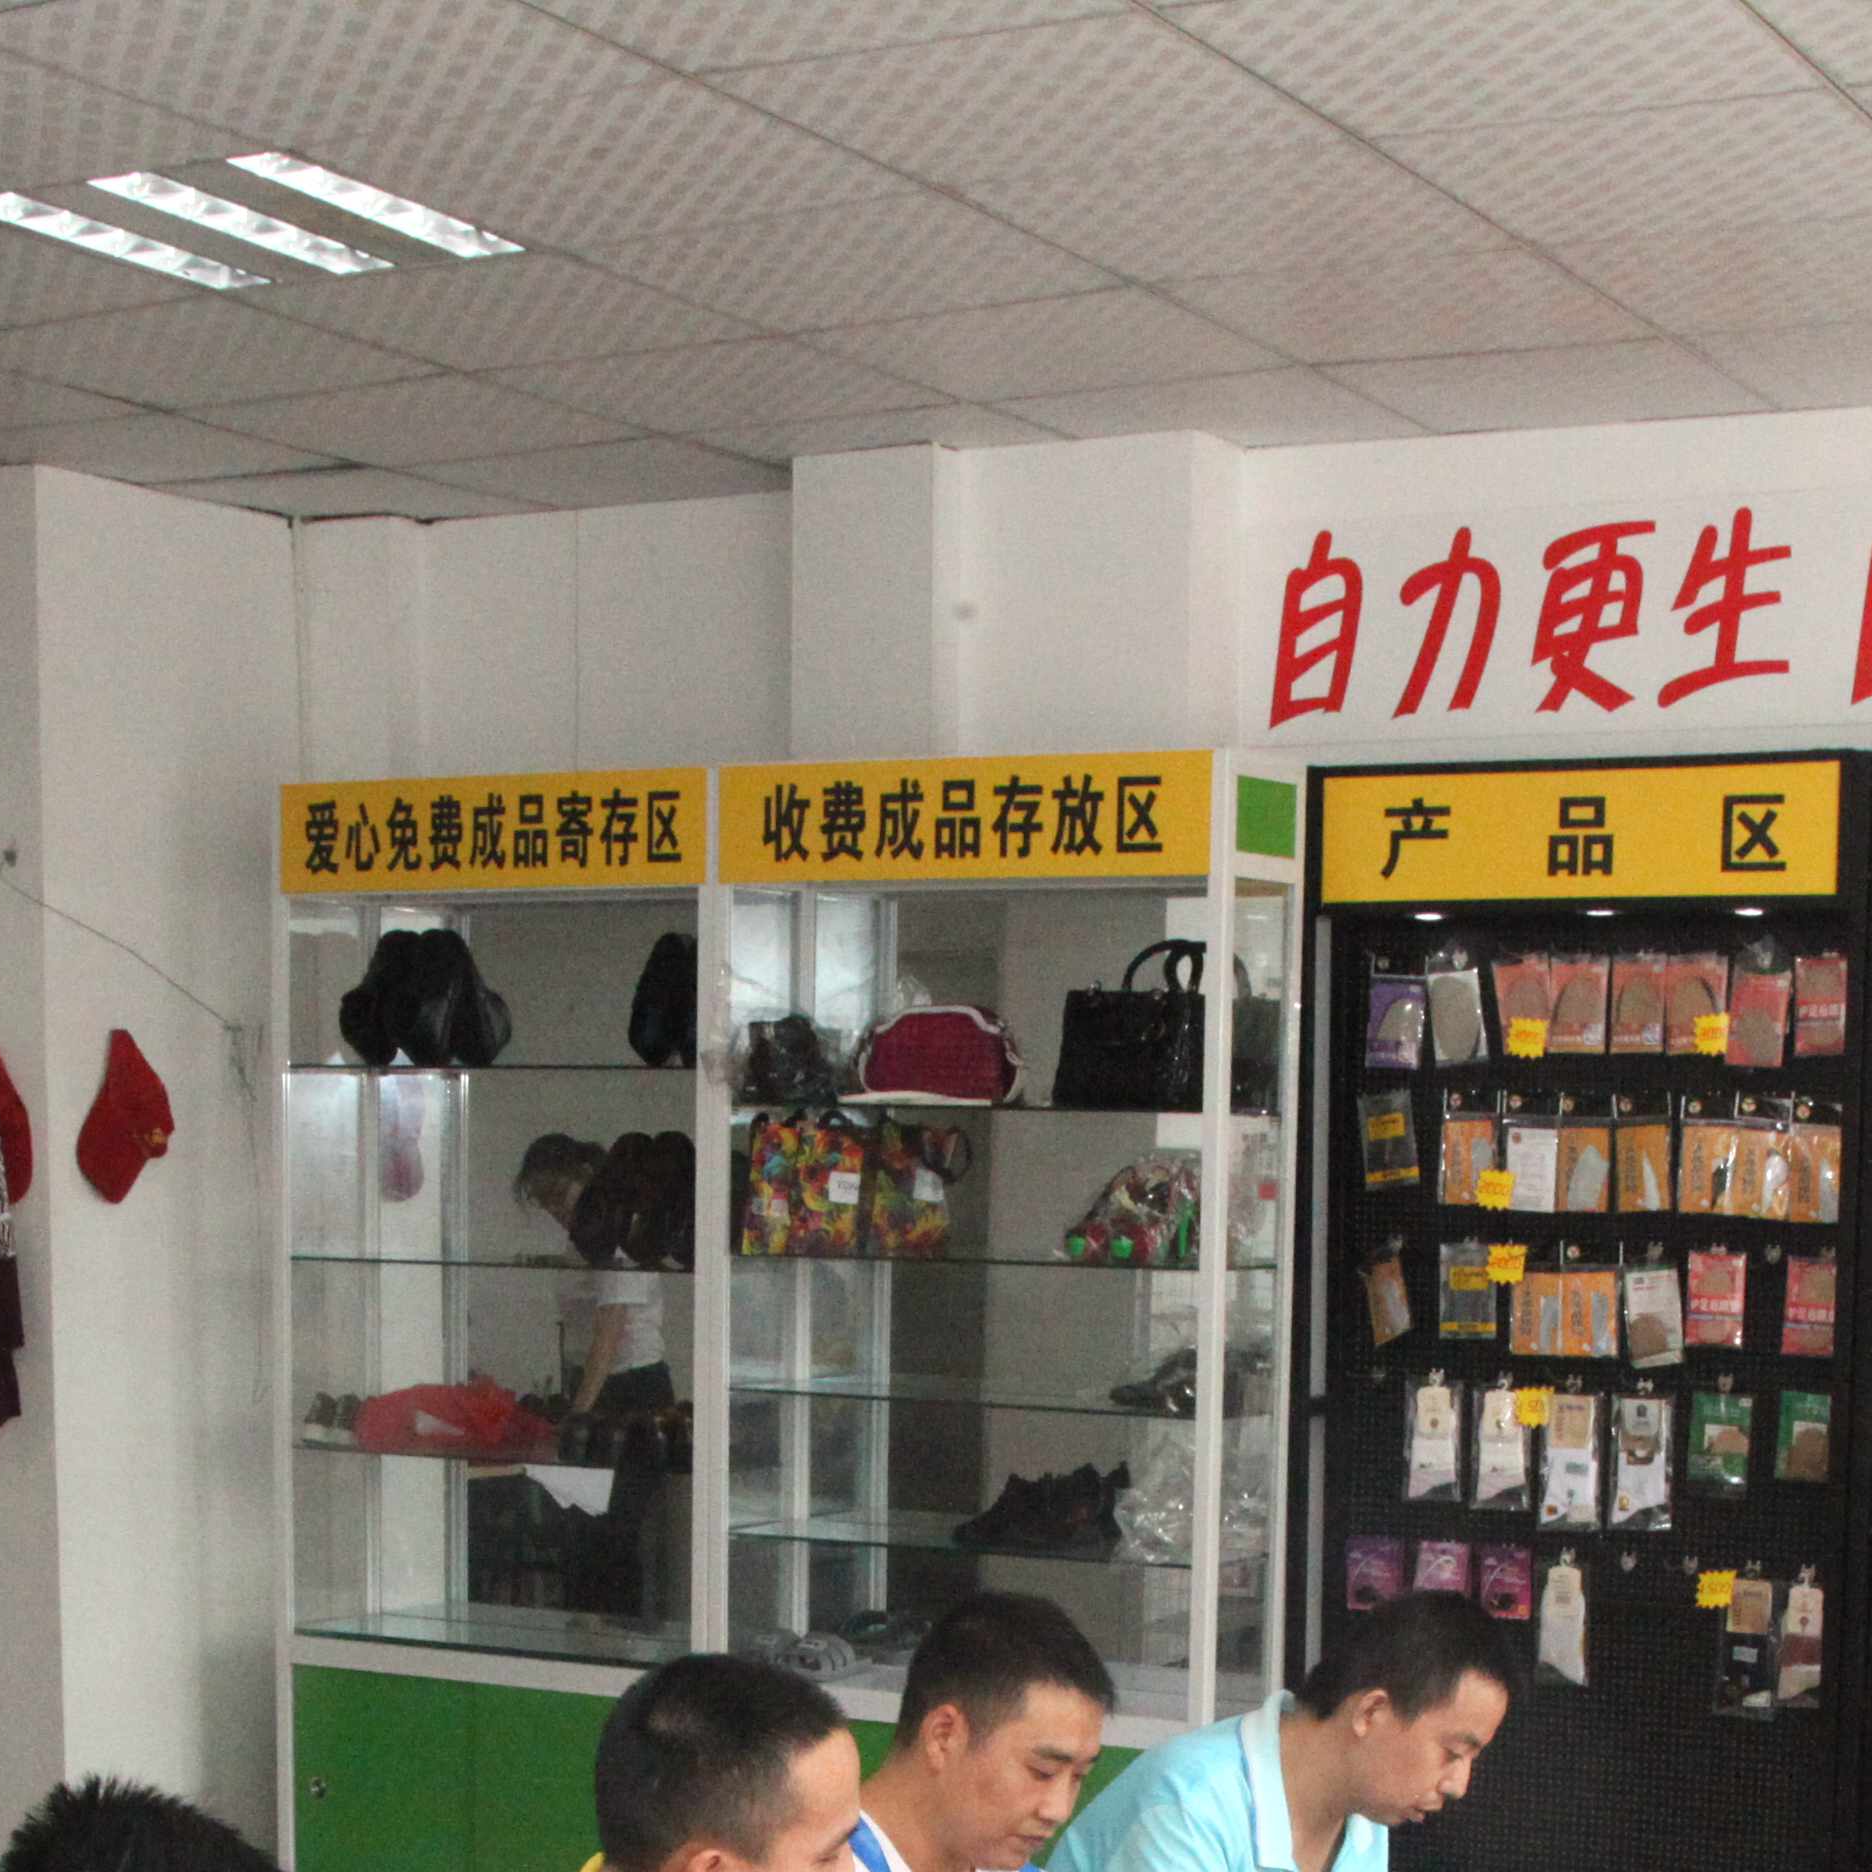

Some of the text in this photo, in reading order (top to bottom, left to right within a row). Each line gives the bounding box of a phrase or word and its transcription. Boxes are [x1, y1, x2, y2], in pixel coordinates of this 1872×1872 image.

[1270, 508, 1791, 727] 自力更生
[304, 789, 684, 875] 爱心免费成品寄存区
[761, 773, 1164, 862] 收费成品存放区
[1380, 793, 1788, 879] 产品区
